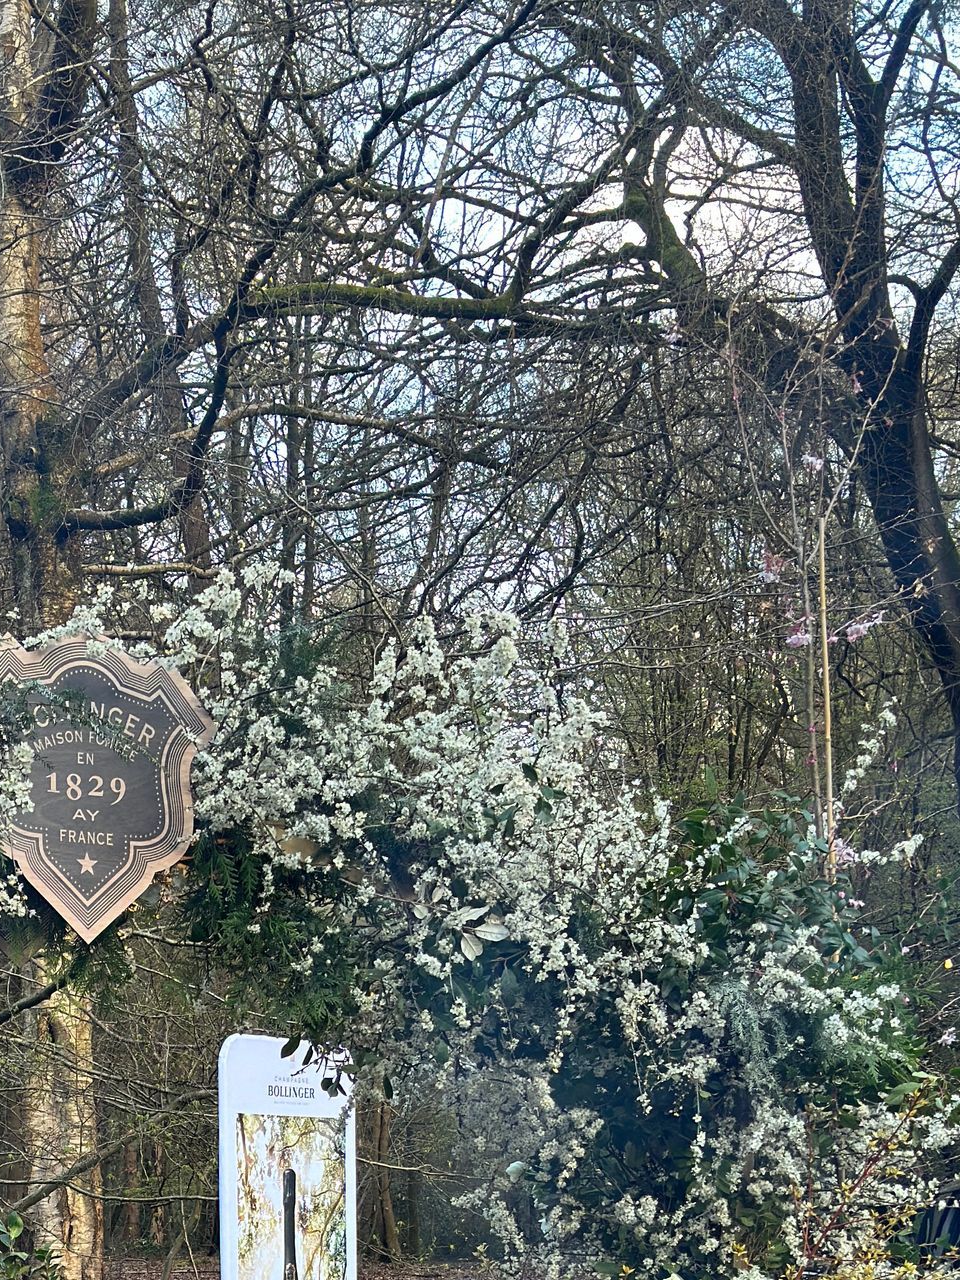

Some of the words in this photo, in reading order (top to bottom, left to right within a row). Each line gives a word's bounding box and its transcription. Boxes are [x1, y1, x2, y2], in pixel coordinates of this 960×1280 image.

[33, 730, 83, 753] MAISON
[77, 751, 94, 765] EN
[45, 772, 126, 806] 1829
[72, 808, 100, 822] AY
[59, 828, 114, 846] FRANCE
[268, 1085, 315, 1099] BOLLINGER
